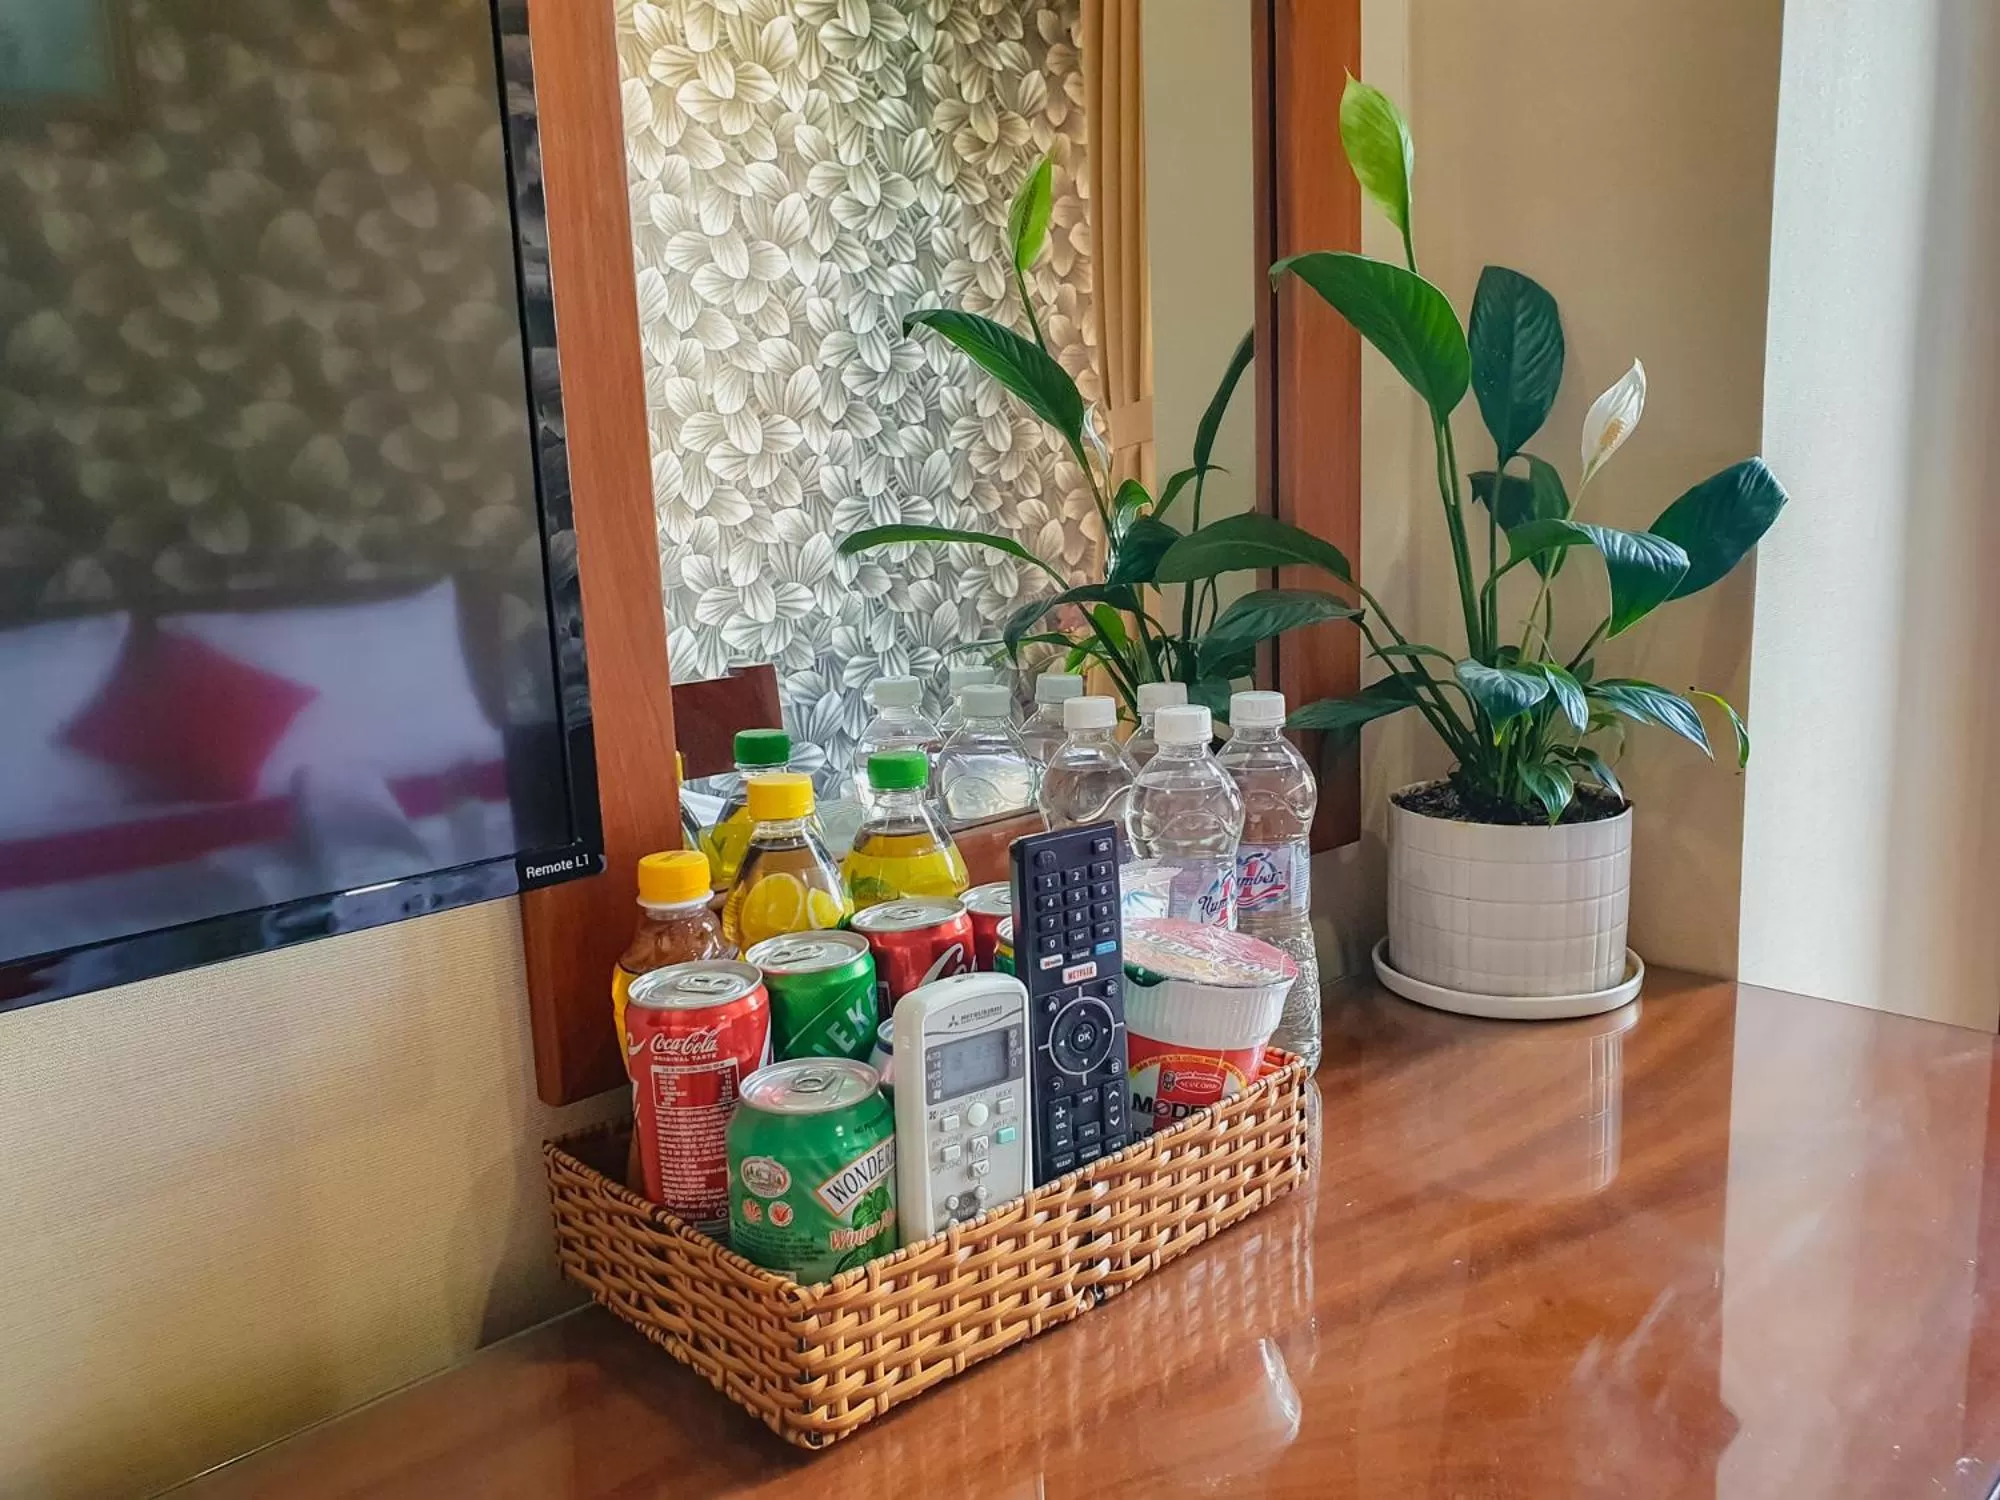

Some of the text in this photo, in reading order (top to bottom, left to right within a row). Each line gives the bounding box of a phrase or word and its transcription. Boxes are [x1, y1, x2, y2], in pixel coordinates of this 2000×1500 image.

[526, 853, 589, 879] Remote L1
[1047, 865, 1107, 887] 1 2 3
[1237, 865, 1282, 886] umber
[1047, 886, 1107, 907] 4 5 6
[1049, 906, 1108, 928] 7 8 9
[1050, 939, 1056, 948] 0
[1077, 1031, 1091, 1042] OK
